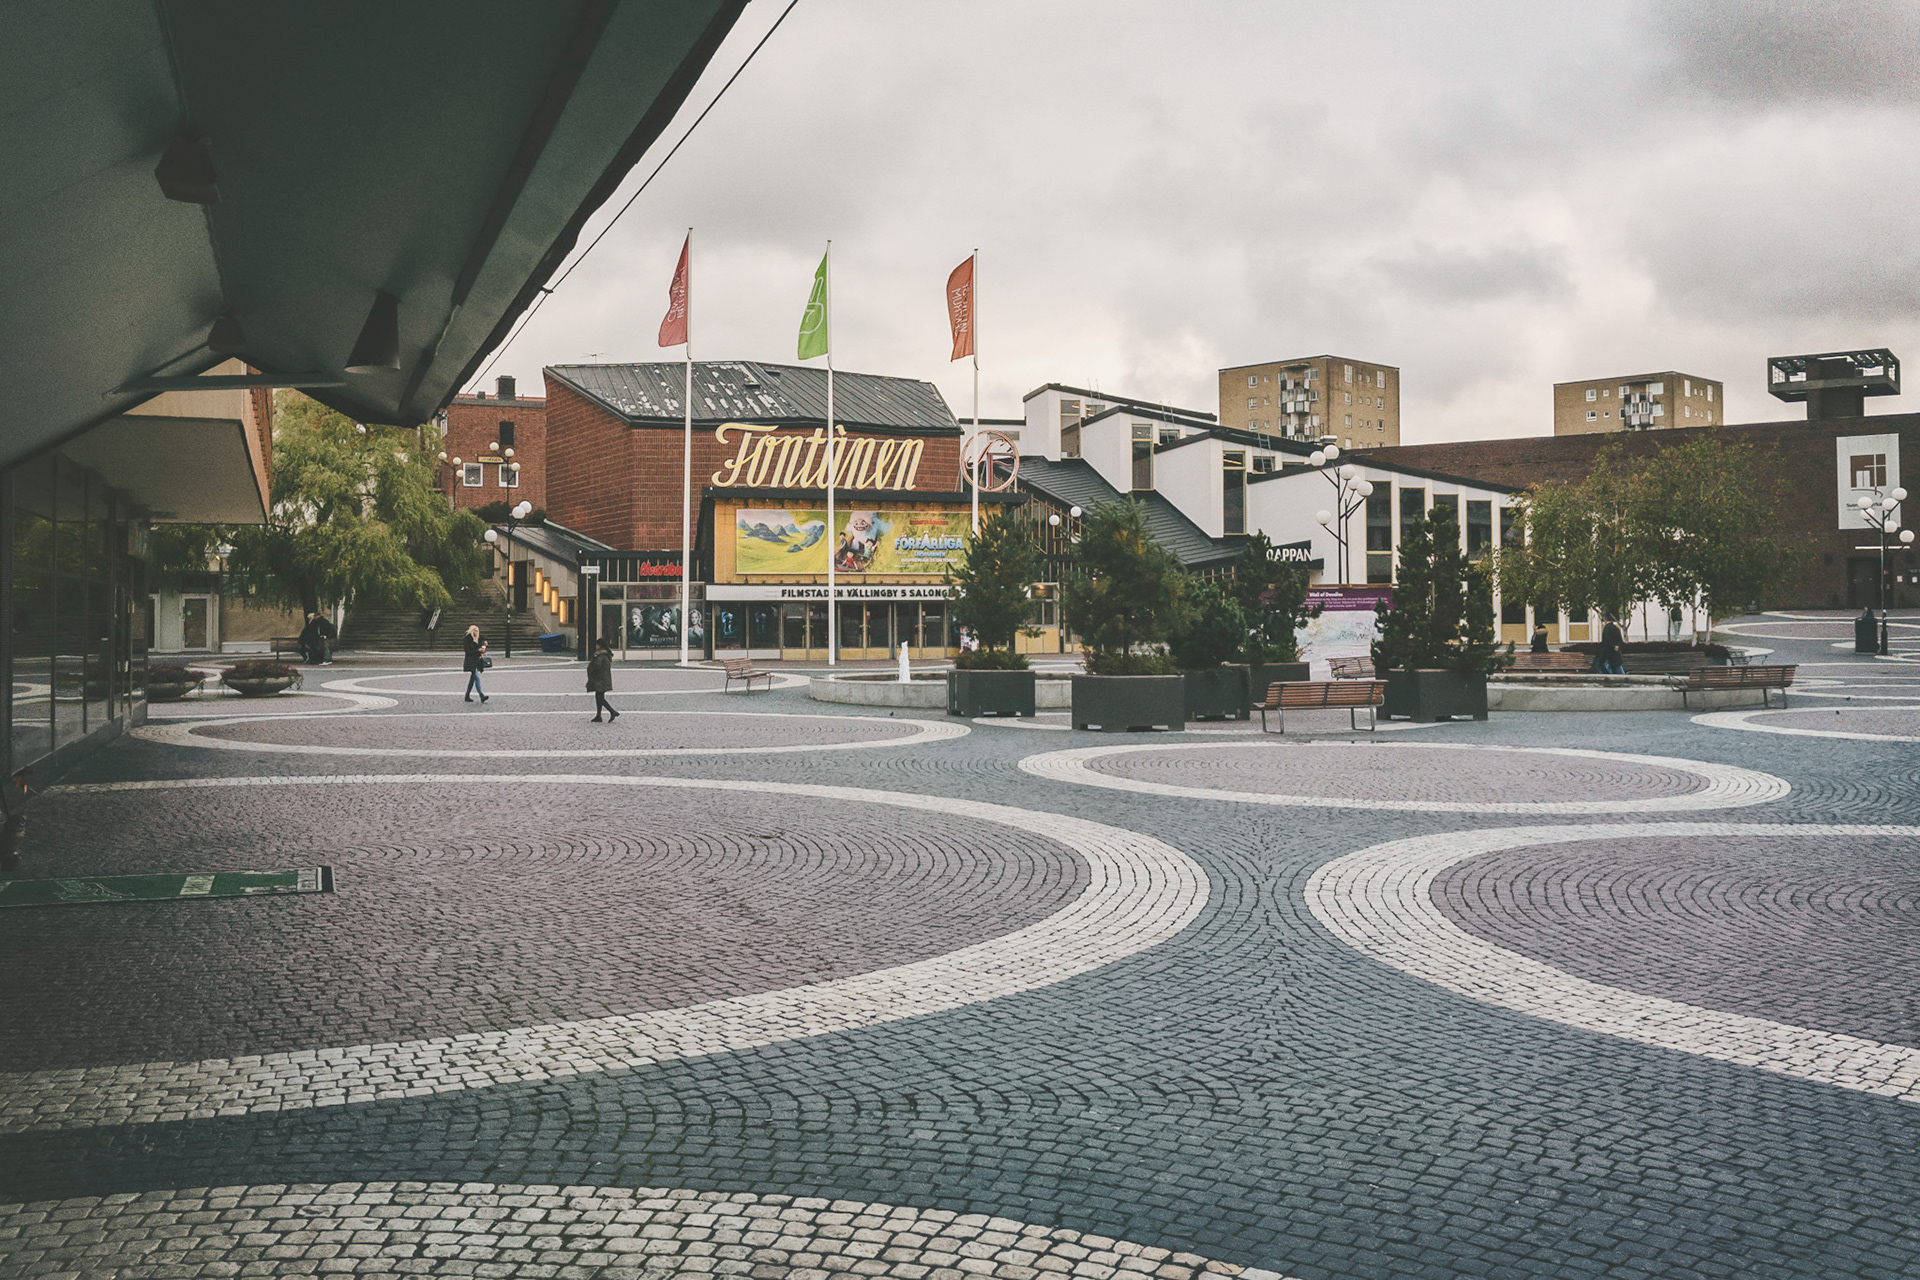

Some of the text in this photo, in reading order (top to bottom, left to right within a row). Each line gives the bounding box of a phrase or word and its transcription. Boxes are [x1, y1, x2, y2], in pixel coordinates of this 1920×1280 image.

[711, 422, 924, 491] Fontänen
[894, 530, 964, 550] FÖRFÄRLIGA
[640, 561, 683, 576] Marabo
[847, 587, 898, 598] VÄLLINGBY
[901, 588, 907, 598] 5
[909, 588, 952, 598] SALONG
